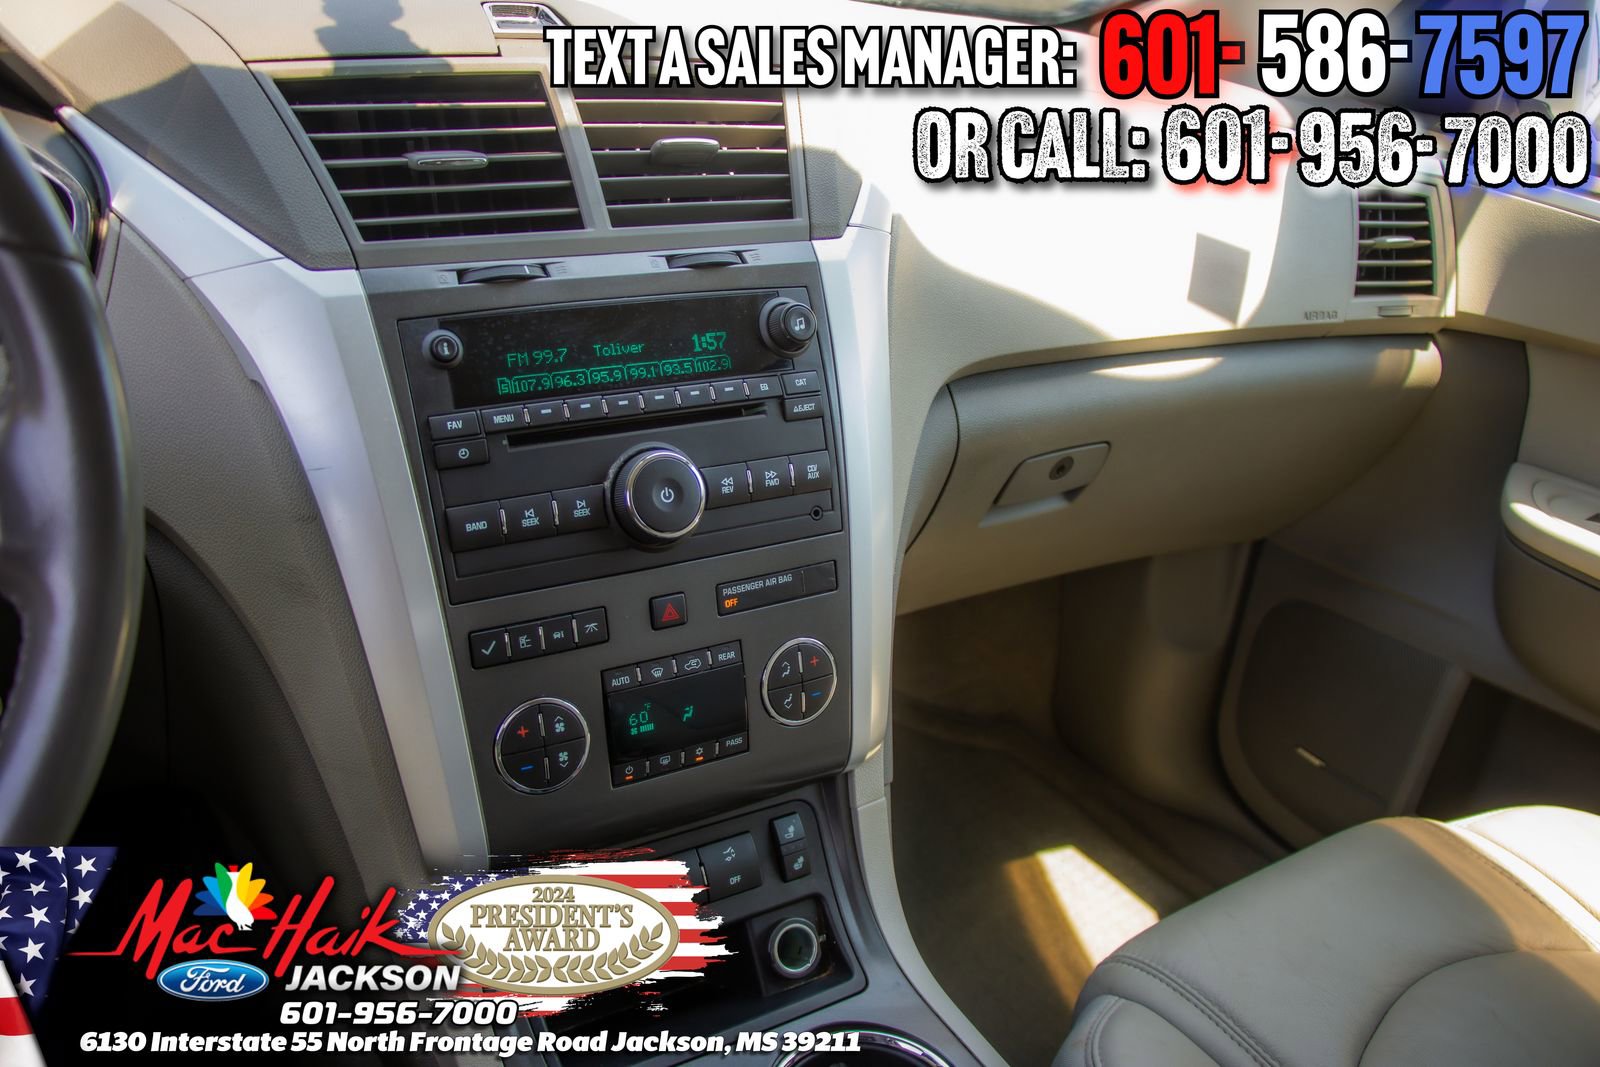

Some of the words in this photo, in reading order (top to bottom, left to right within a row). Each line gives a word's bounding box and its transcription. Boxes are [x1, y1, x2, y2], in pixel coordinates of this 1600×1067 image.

[507, 351, 529, 368] FM
[532, 347, 568, 365] 99.7
[593, 342, 645, 358] Toliver
[692, 331, 727, 353] 1:57
[514, 377, 551, 394] 107.9
[554, 373, 586, 388] 96.3
[591, 369, 622, 385] 95.9
[630, 365, 657, 380] 99.1
[663, 361, 693, 376] 93.5
[697, 357, 729, 373] 102.9
[795, 377, 808, 388] CAT
[447, 419, 463, 431] FAV
[493, 413, 515, 425] MENU
[807, 470, 820, 481] AUX
[765, 477, 780, 487] FWD
[721, 485, 735, 495] REV
[574, 506, 591, 518] SEEK
[465, 520, 488, 533] BAND
[522, 516, 540, 528] SEEK
[722, 580, 763, 597] PASSENGER
[765, 577, 777, 588] AIR
[777, 573, 793, 585] BAG
[724, 597, 738, 609] OFF
[718, 651, 736, 662] REAR
[611, 675, 630, 687] AUTO
[726, 737, 743, 747] PASS
[729, 875, 742, 886] OFF
